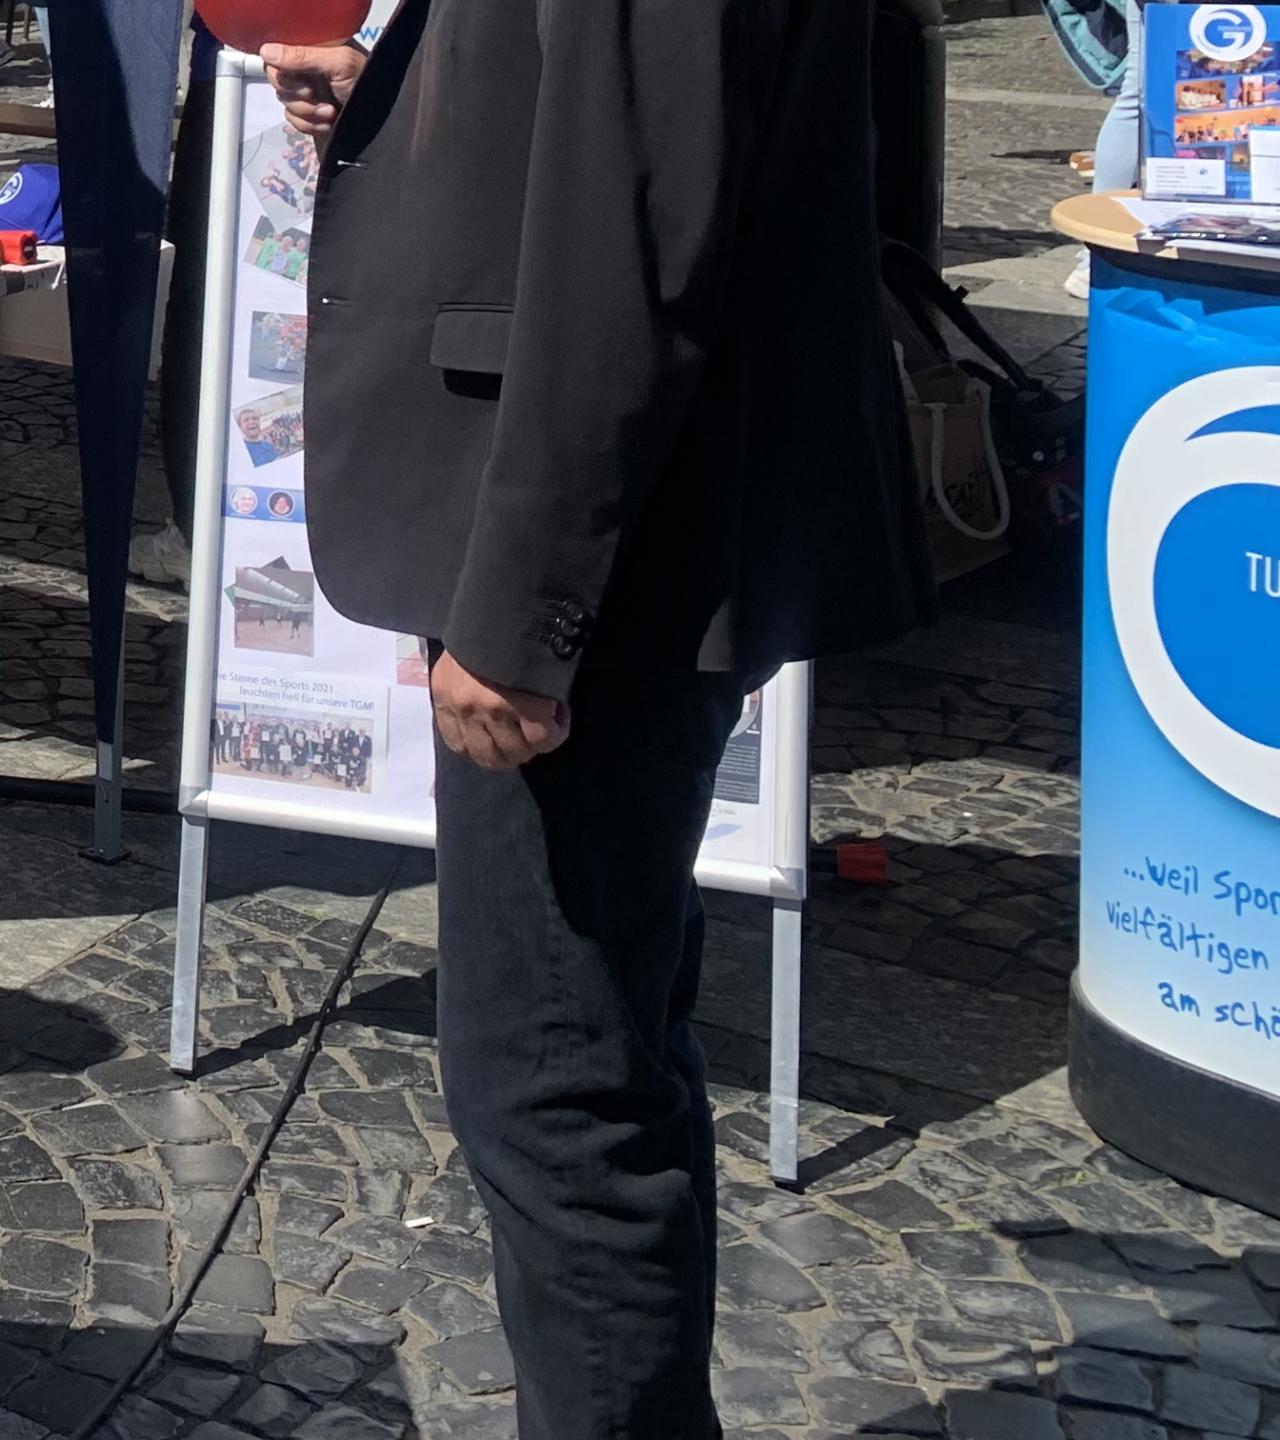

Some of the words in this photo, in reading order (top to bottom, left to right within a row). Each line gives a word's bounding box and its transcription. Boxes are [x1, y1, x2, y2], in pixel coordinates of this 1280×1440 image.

[229, 671, 259, 685] Sterne
[261, 675, 278, 687] des
[279, 678, 309, 691] Sports
[311, 682, 334, 694] 2021
[239, 685, 280, 700] leuchten
[282, 691, 299, 703] hell
[301, 693, 315, 704] für
[316, 698, 349, 709] unsere
[1158, 981, 1200, 1018] am
